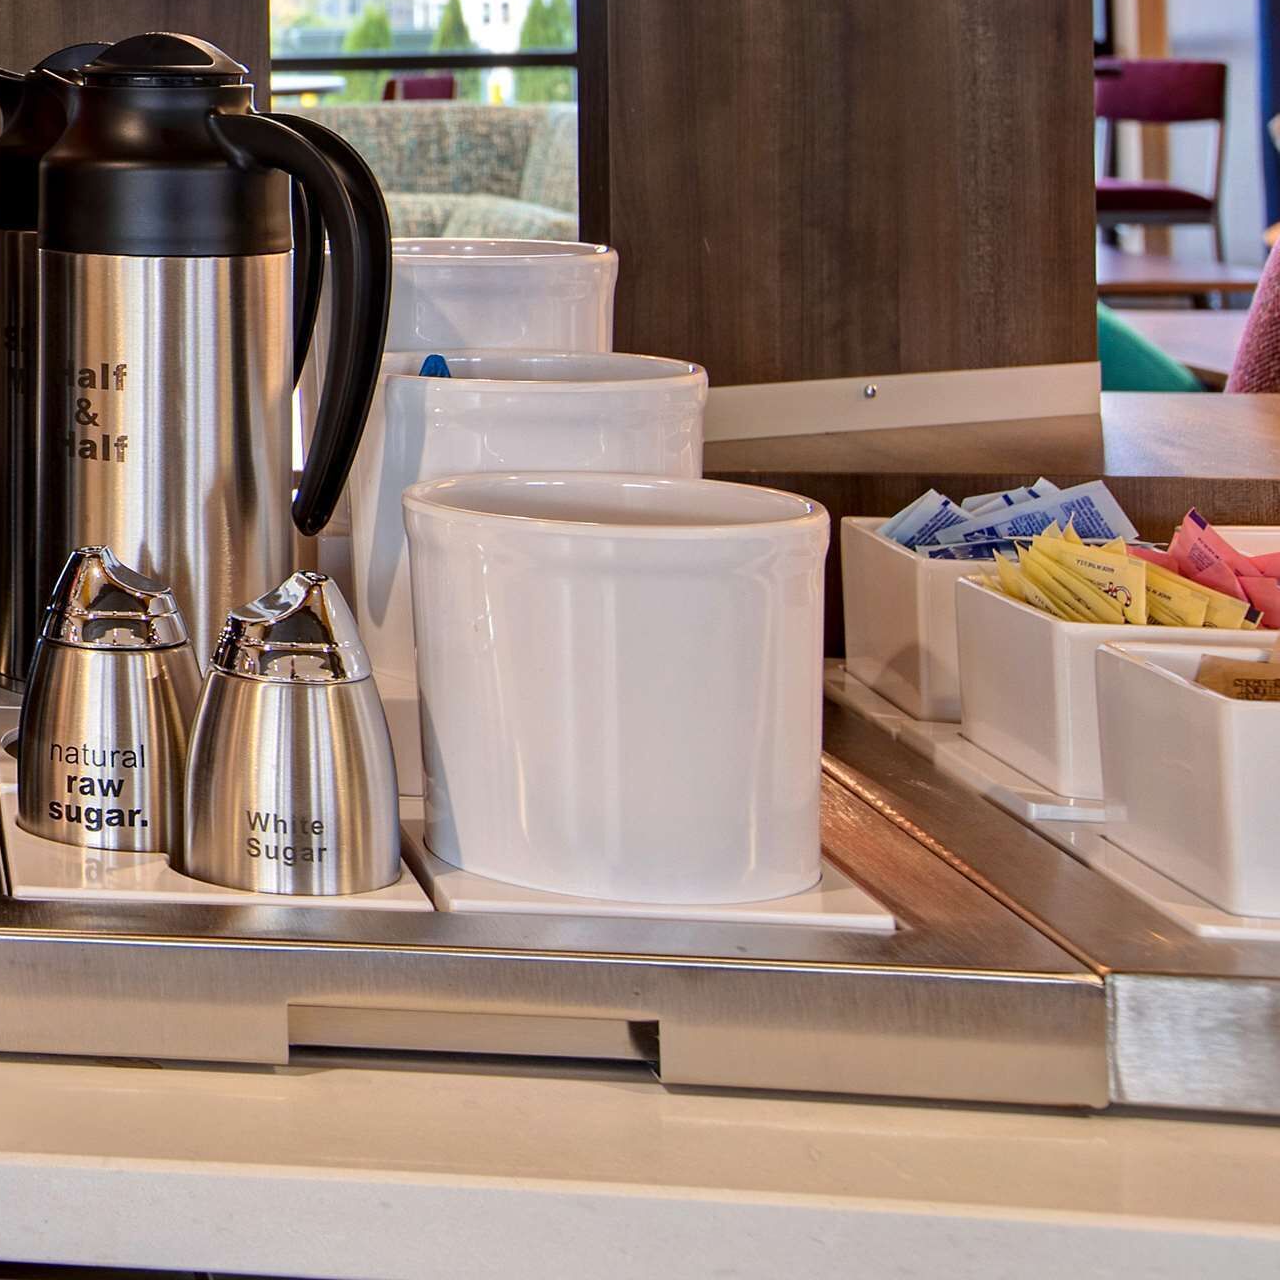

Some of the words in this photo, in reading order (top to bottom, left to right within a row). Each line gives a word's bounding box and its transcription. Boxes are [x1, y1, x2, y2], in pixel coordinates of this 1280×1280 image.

[75, 397, 100, 427] &
[50, 742, 145, 768] natural
[67, 773, 125, 798] raw
[48, 800, 148, 832] sugar.
[246, 809, 325, 836] White
[246, 838, 328, 867] Sugar
